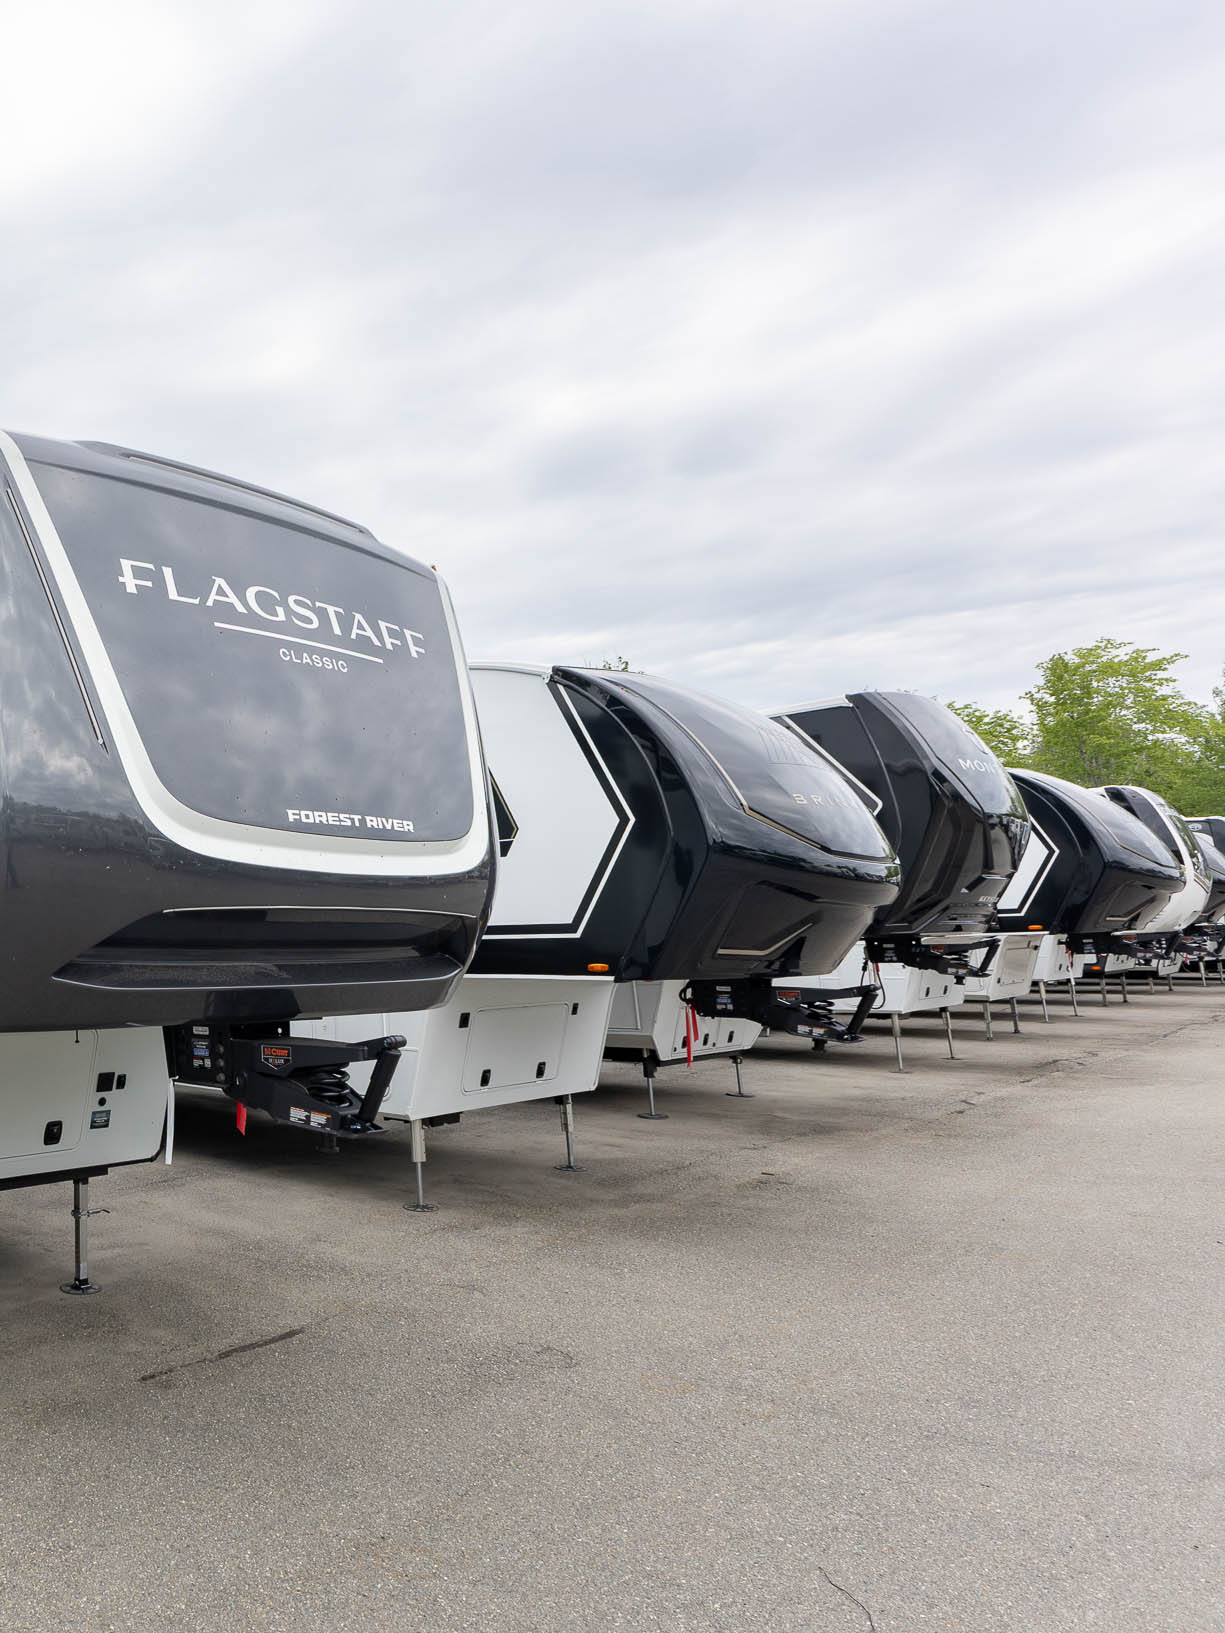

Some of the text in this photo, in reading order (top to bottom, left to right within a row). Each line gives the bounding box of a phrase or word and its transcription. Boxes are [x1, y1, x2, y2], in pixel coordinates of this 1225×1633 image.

[118, 558, 425, 658] FLAGSTAFF
[279, 648, 348, 673] CLASSIC
[286, 809, 415, 833] FOREST RIVER
